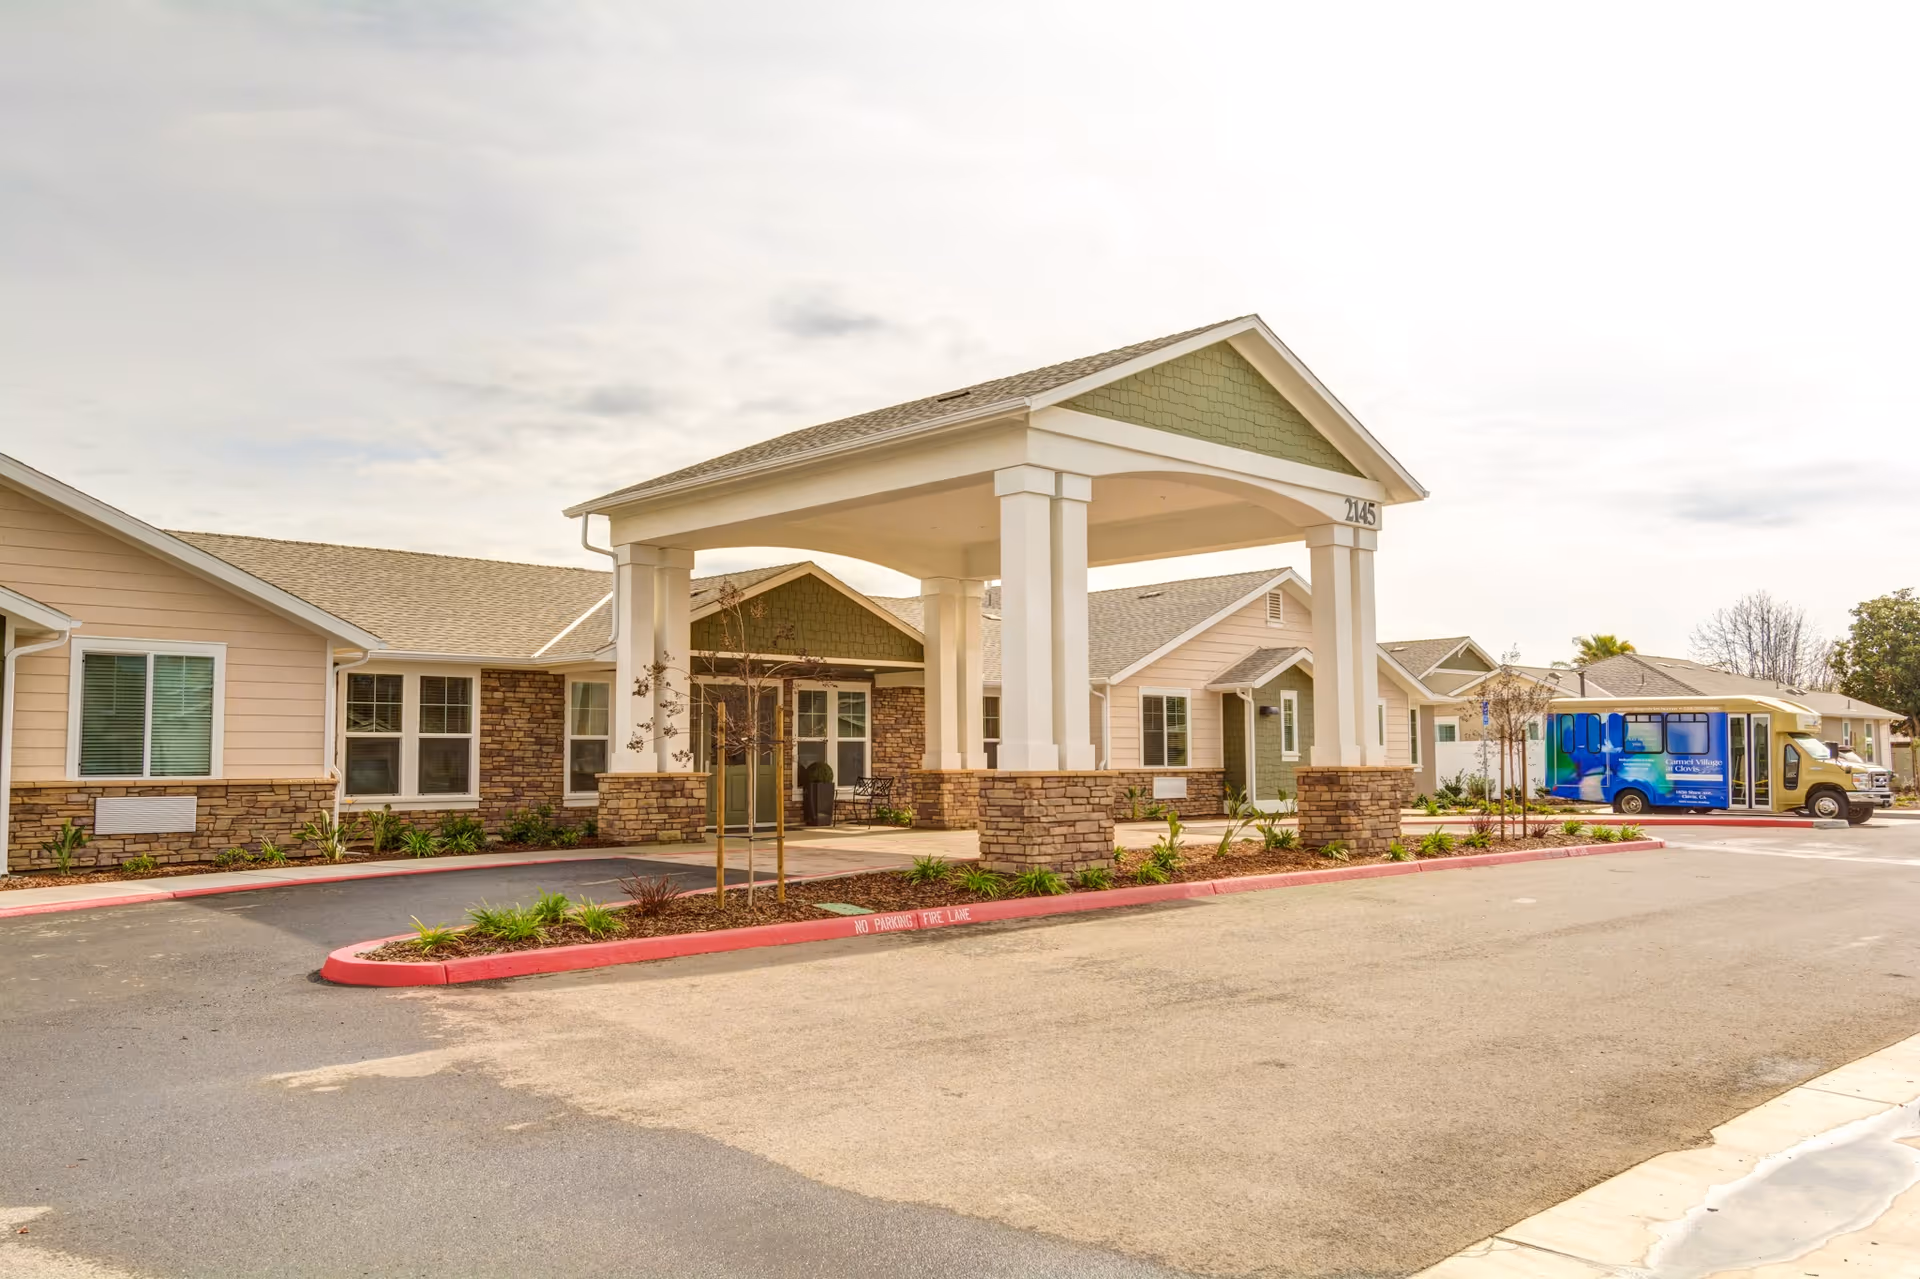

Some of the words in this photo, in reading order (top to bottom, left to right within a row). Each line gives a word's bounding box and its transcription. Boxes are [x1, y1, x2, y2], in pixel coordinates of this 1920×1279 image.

[1344, 497, 1376, 525] 2145
[1665, 758, 1694, 766] Carmel
[1695, 758, 1723, 767] Village
[854, 919, 869, 935] NO
[874, 914, 913, 932] PARKING
[923, 910, 945, 925] FIRE
[947, 907, 972, 922] LANE
